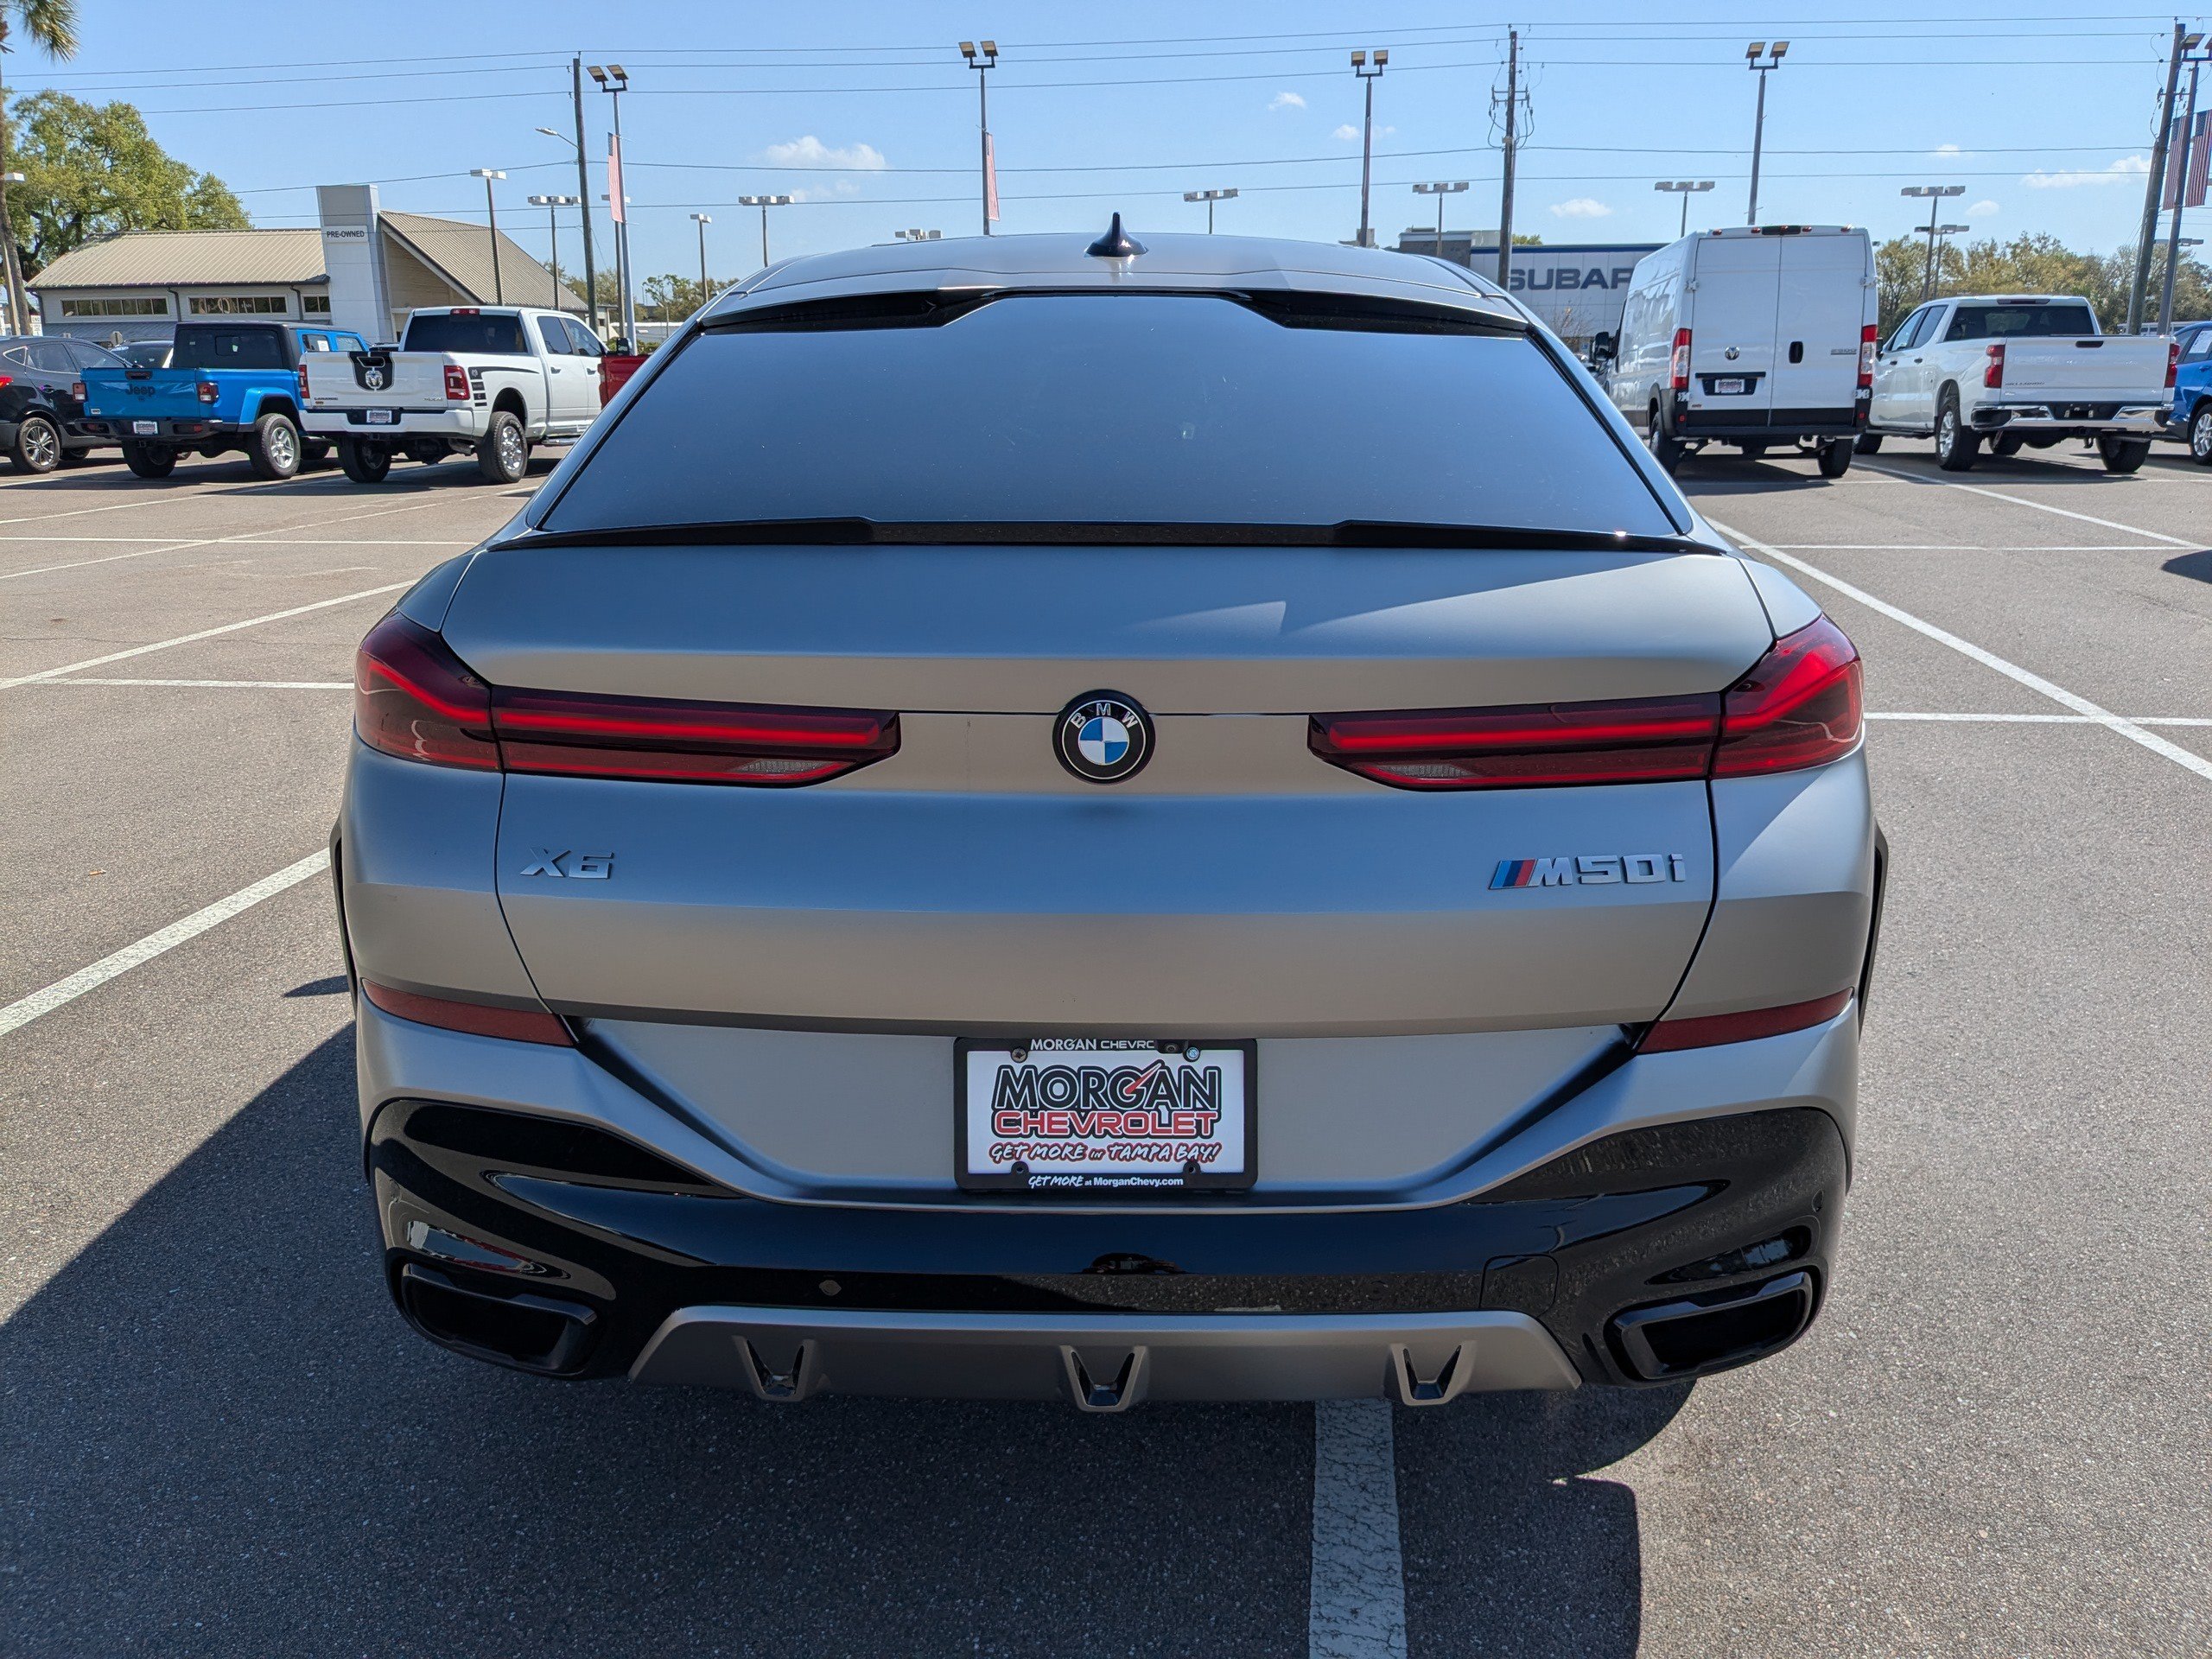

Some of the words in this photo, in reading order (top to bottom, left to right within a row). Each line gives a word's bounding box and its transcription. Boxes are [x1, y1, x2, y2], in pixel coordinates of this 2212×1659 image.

[125, 384, 156, 397] Jeep
[1070, 702, 1139, 729] BMW
[519, 846, 614, 880] X6
[1528, 854, 1686, 887] M50i
[1030, 1039, 1096, 1051] MORGAN
[993, 1063, 1220, 1110] MORGAN
[993, 1110, 1219, 1137] CHEVROLET
[990, 1143, 1029, 1162] GET
[1029, 1143, 1086, 1160] MORE
[1108, 1143, 1172, 1161] TAMPA
[1175, 1143, 1220, 1162] BAY!
[1028, 1175, 1051, 1189] GET
[1050, 1175, 1084, 1187] MORE
[1093, 1177, 1184, 1186] MorganChevy.com
